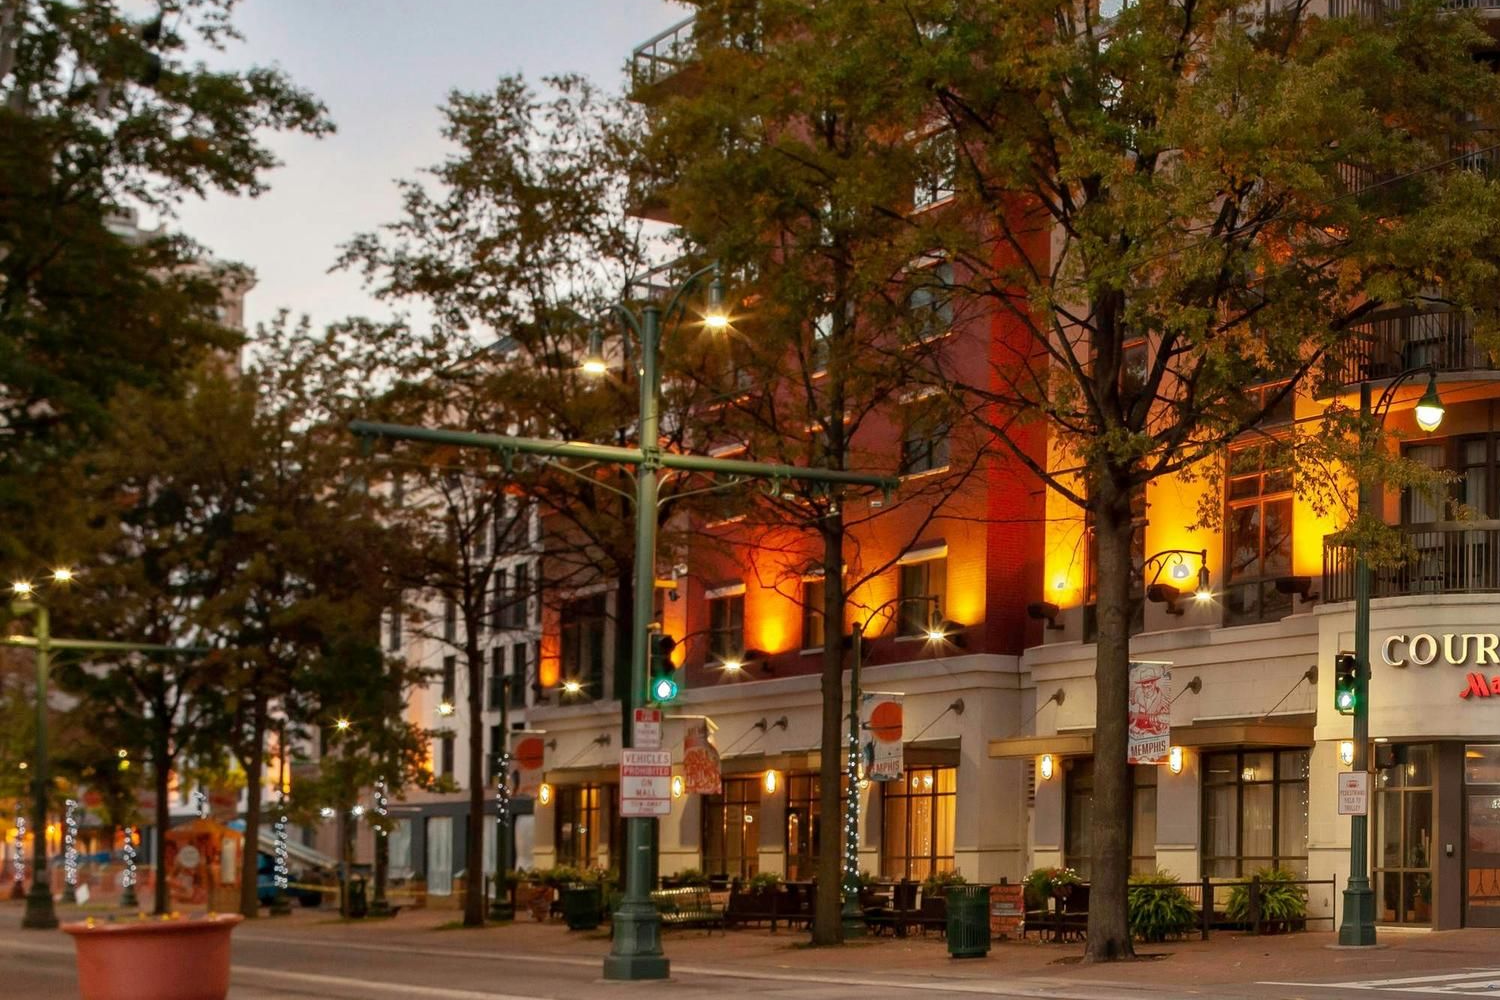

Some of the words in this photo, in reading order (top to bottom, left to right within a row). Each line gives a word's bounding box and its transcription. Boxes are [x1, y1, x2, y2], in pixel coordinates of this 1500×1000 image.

[1131, 740, 1166, 757] MEMPHIS
[625, 754, 670, 764] VEHICLES
[624, 767, 670, 775] PROHIBITED
[641, 779, 653, 787] ON
